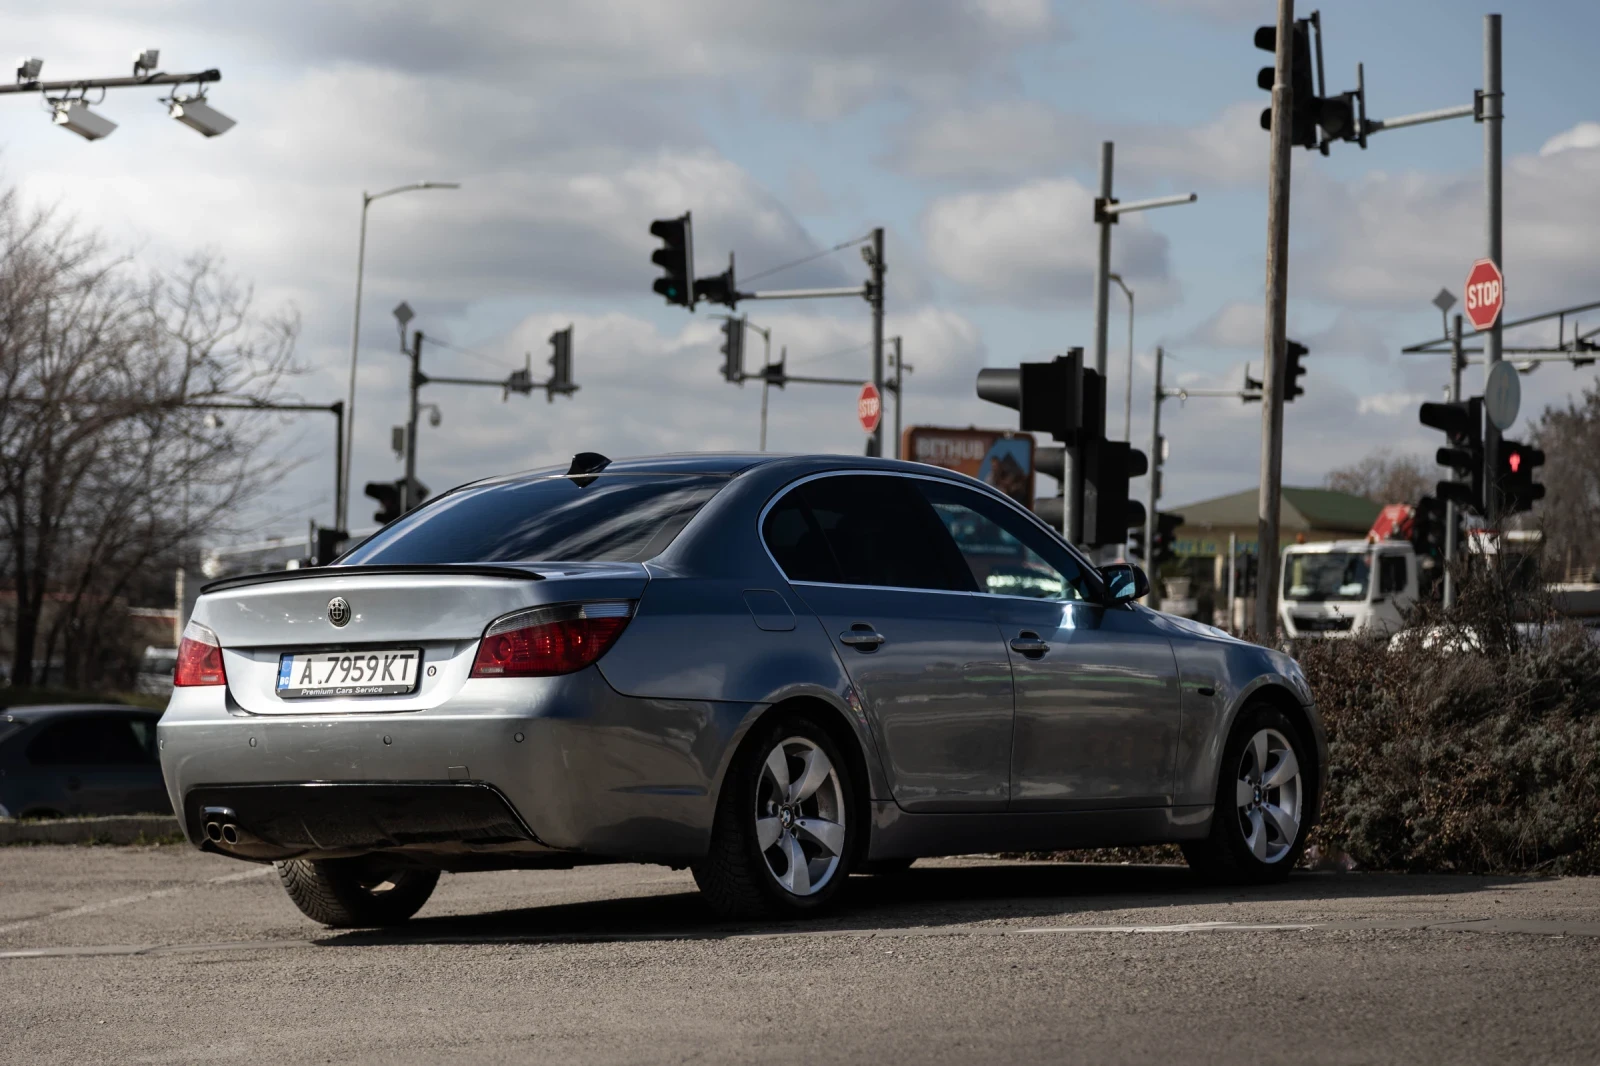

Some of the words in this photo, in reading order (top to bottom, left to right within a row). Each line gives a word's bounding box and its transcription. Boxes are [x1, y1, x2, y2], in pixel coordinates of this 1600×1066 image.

[1468, 280, 1499, 309] STOP
[859, 397, 879, 418] STOP
[301, 688, 334, 696] Premium
[355, 686, 383, 694] Service
